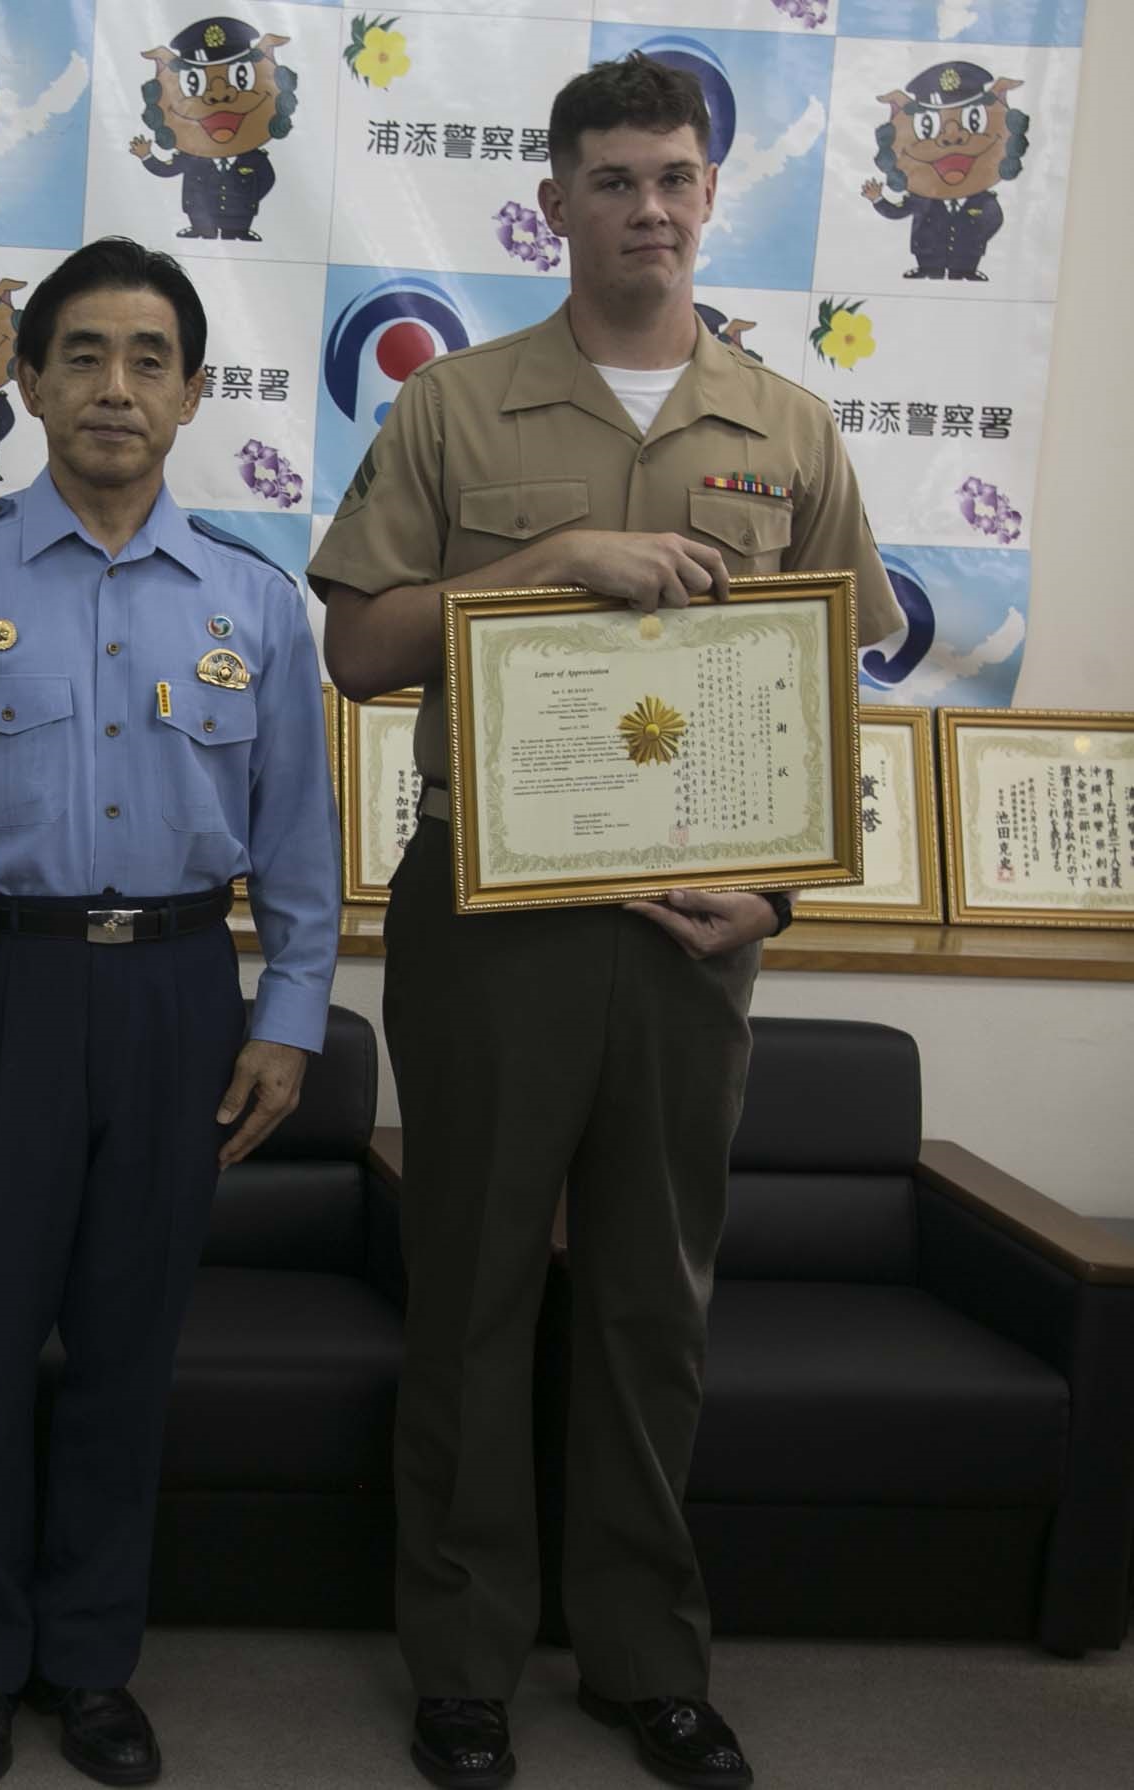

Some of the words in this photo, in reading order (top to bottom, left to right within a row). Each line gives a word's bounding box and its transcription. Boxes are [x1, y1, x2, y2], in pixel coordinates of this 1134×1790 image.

[367, 119, 550, 162] 浦添警察署
[833, 398, 1013, 440] 浦添警察署
[395, 796, 409, 848] 加藤達也
[996, 810, 1012, 871] 池田克史
[1075, 765, 1091, 887] 大会第二部において
